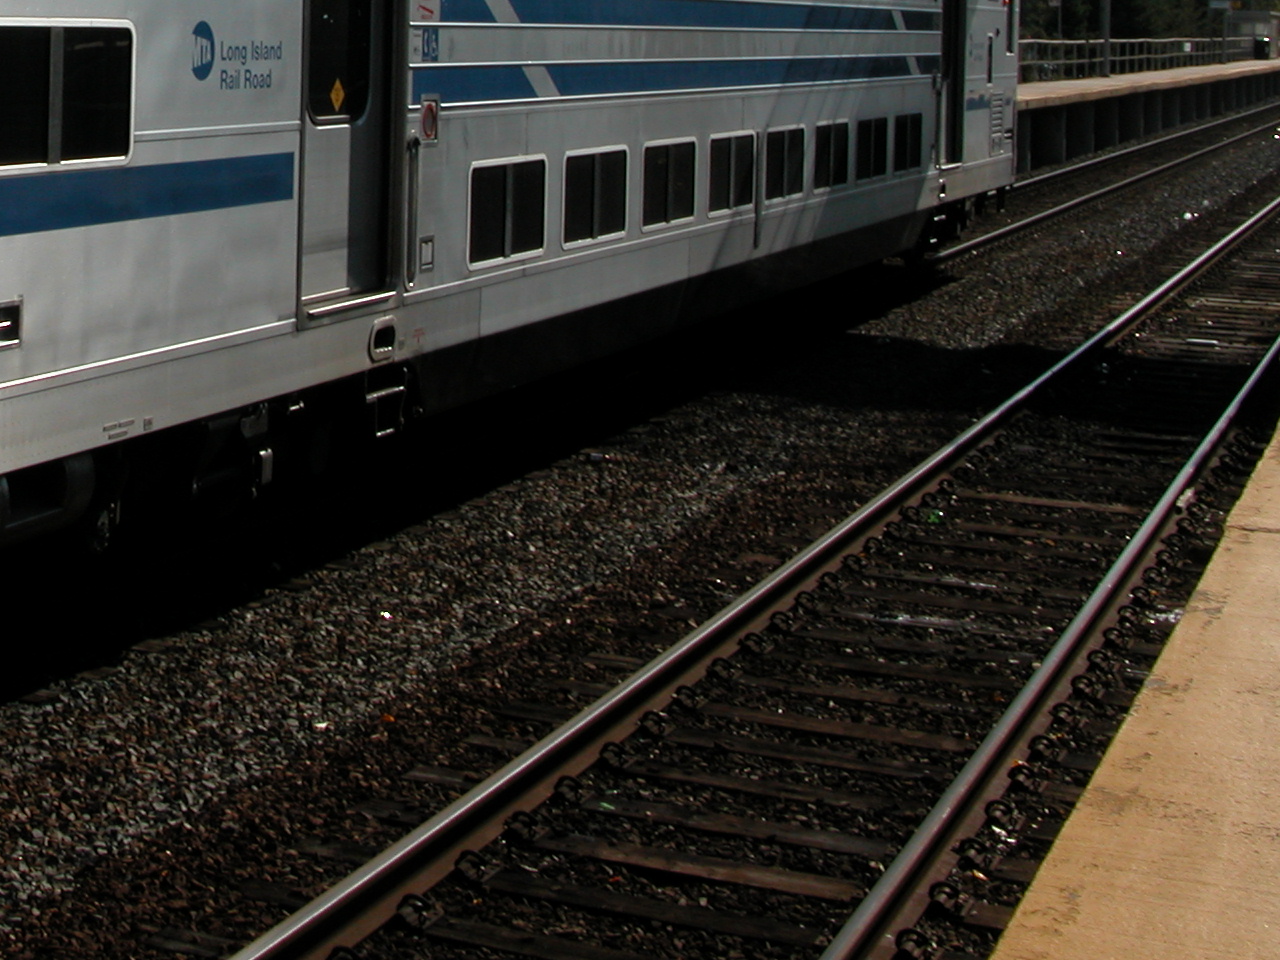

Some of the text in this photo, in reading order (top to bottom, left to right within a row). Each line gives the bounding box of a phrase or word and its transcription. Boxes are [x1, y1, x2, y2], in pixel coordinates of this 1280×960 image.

[190, 34, 212, 69] MTA
[220, 40, 282, 65] Long Island
[219, 69, 272, 90] Rail Road
